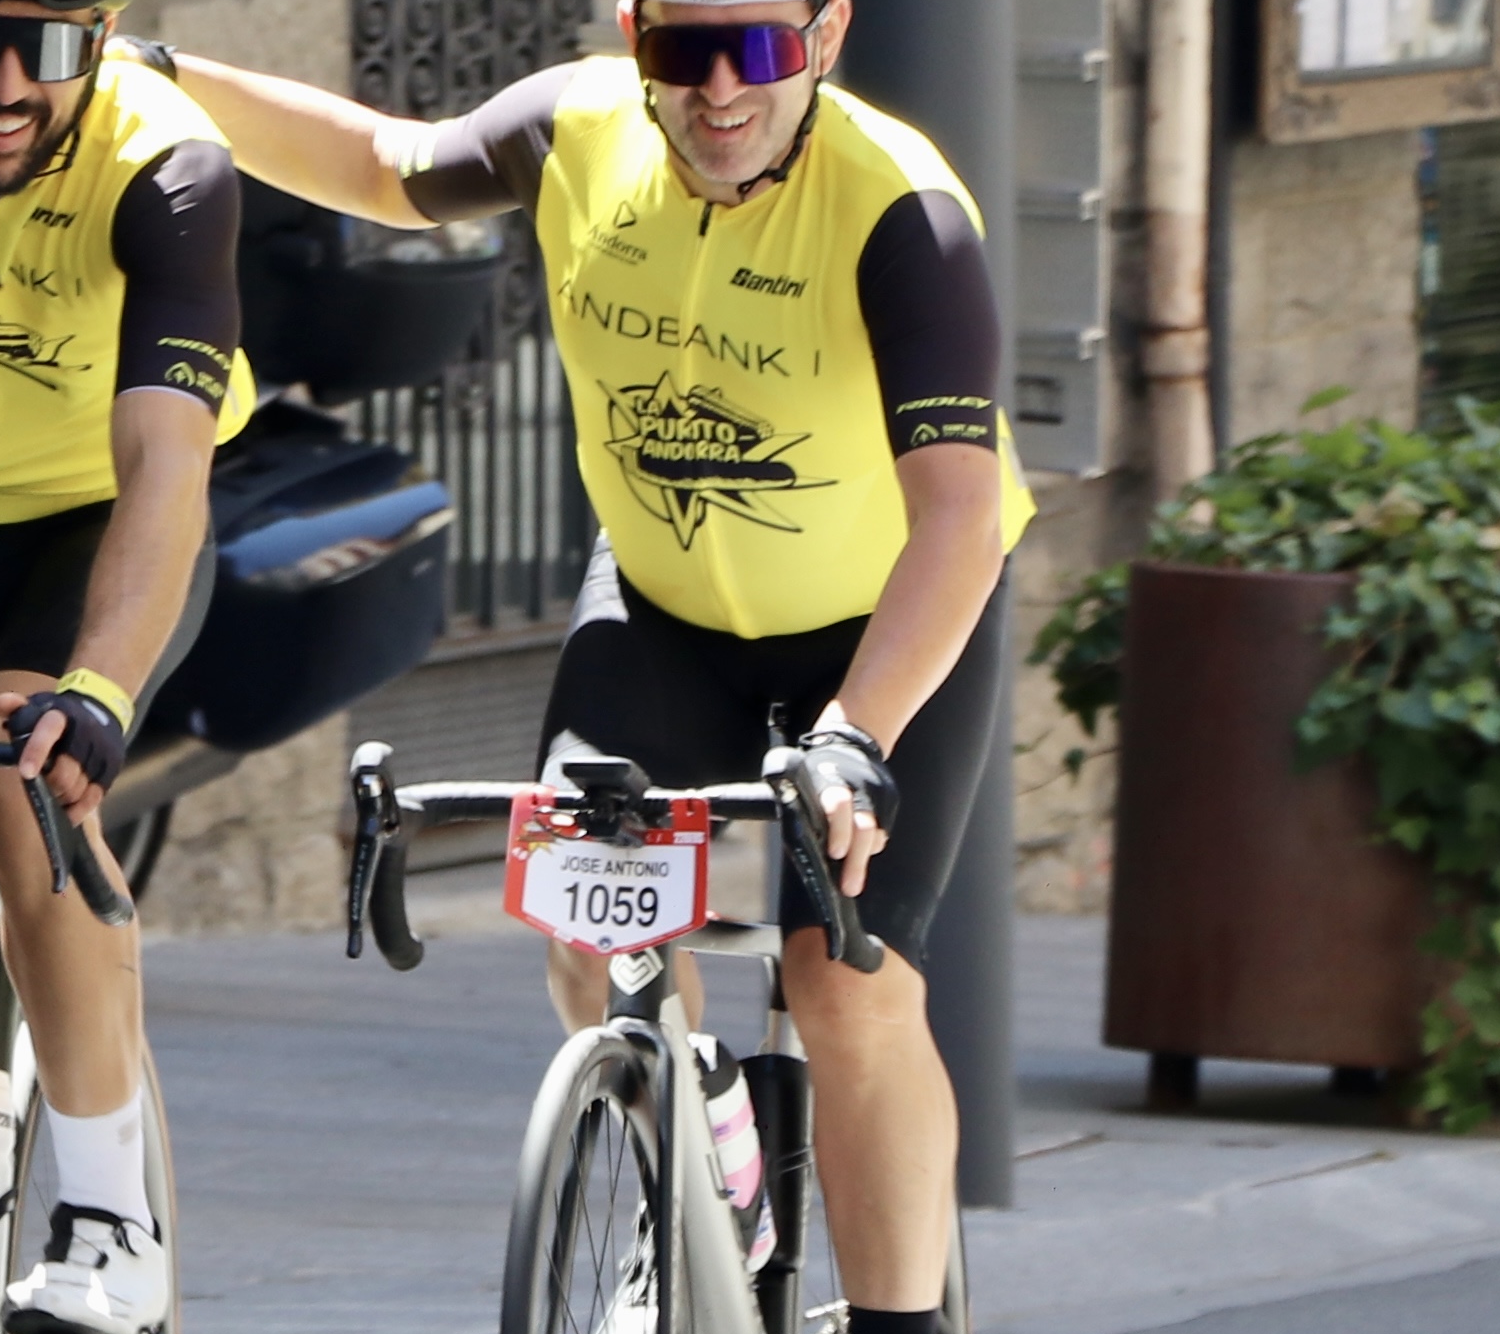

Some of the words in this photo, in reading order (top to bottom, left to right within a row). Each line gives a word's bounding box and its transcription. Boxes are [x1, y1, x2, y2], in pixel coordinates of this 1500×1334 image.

[730, 267, 807, 299] Santini
[560, 854, 601, 875] JOSE
[603, 859, 670, 878] ANTONIO
[563, 881, 660, 928] 1059
